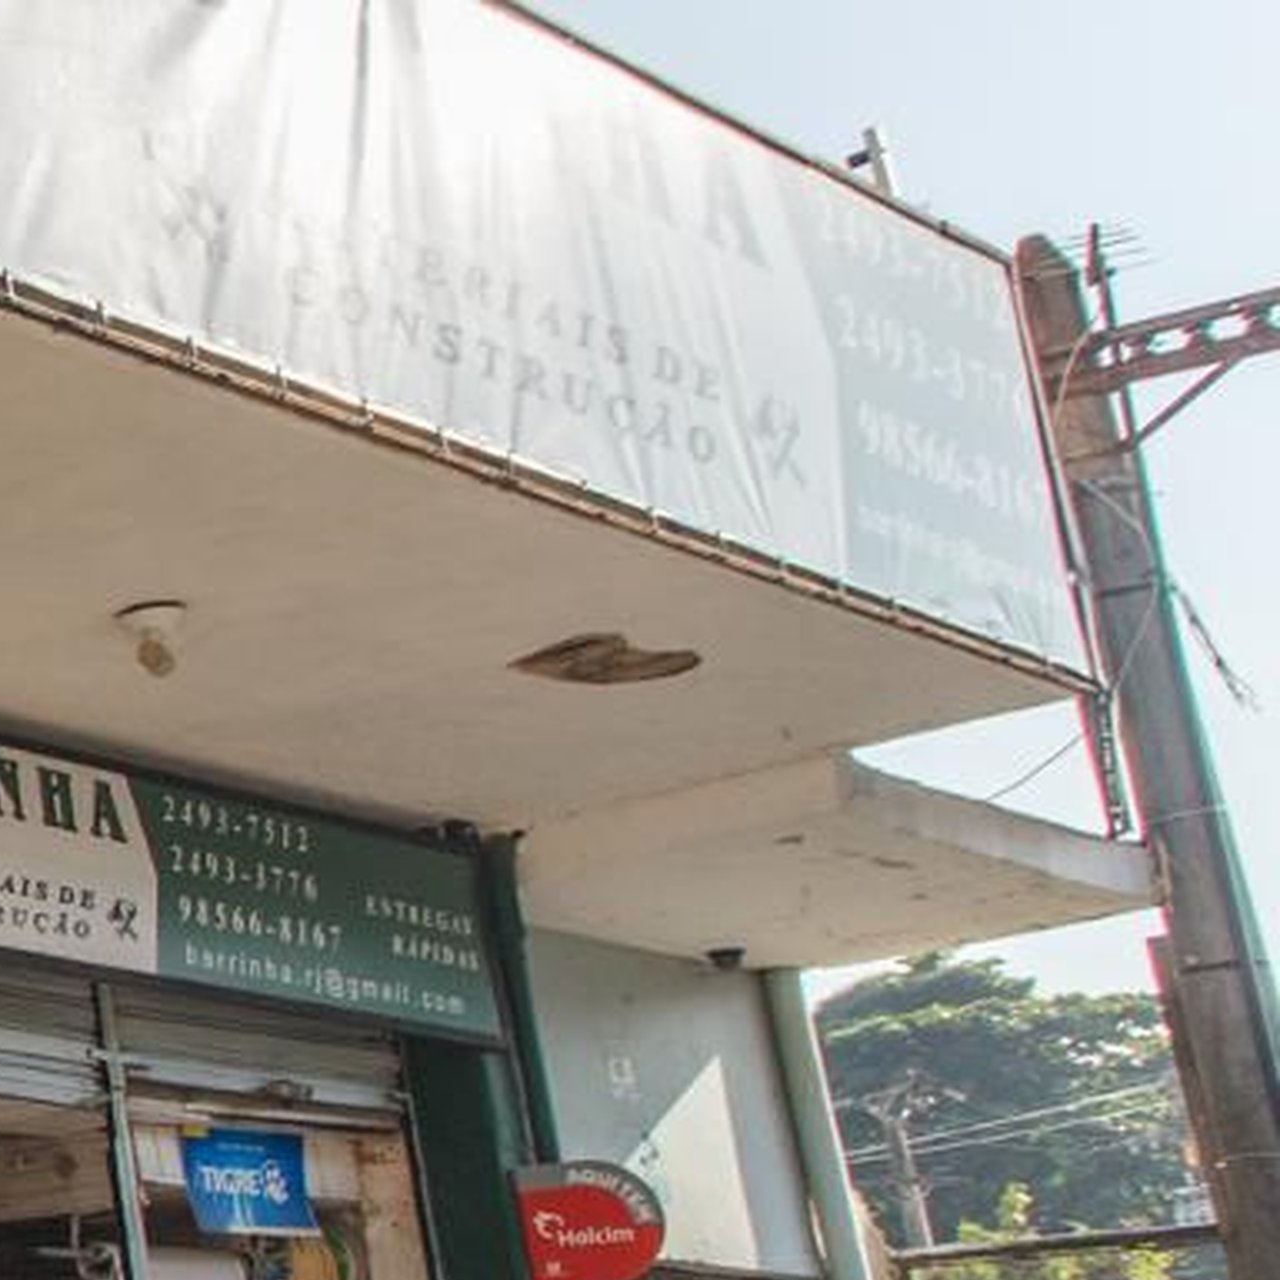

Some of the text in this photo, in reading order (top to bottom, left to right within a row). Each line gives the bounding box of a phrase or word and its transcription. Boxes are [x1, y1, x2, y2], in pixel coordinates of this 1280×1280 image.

[653, 344, 722, 401] DE
[161, 795, 312, 853] 2493-7512
[58, 885, 98, 912] DE
[558, 1225, 636, 1249] Holcim
